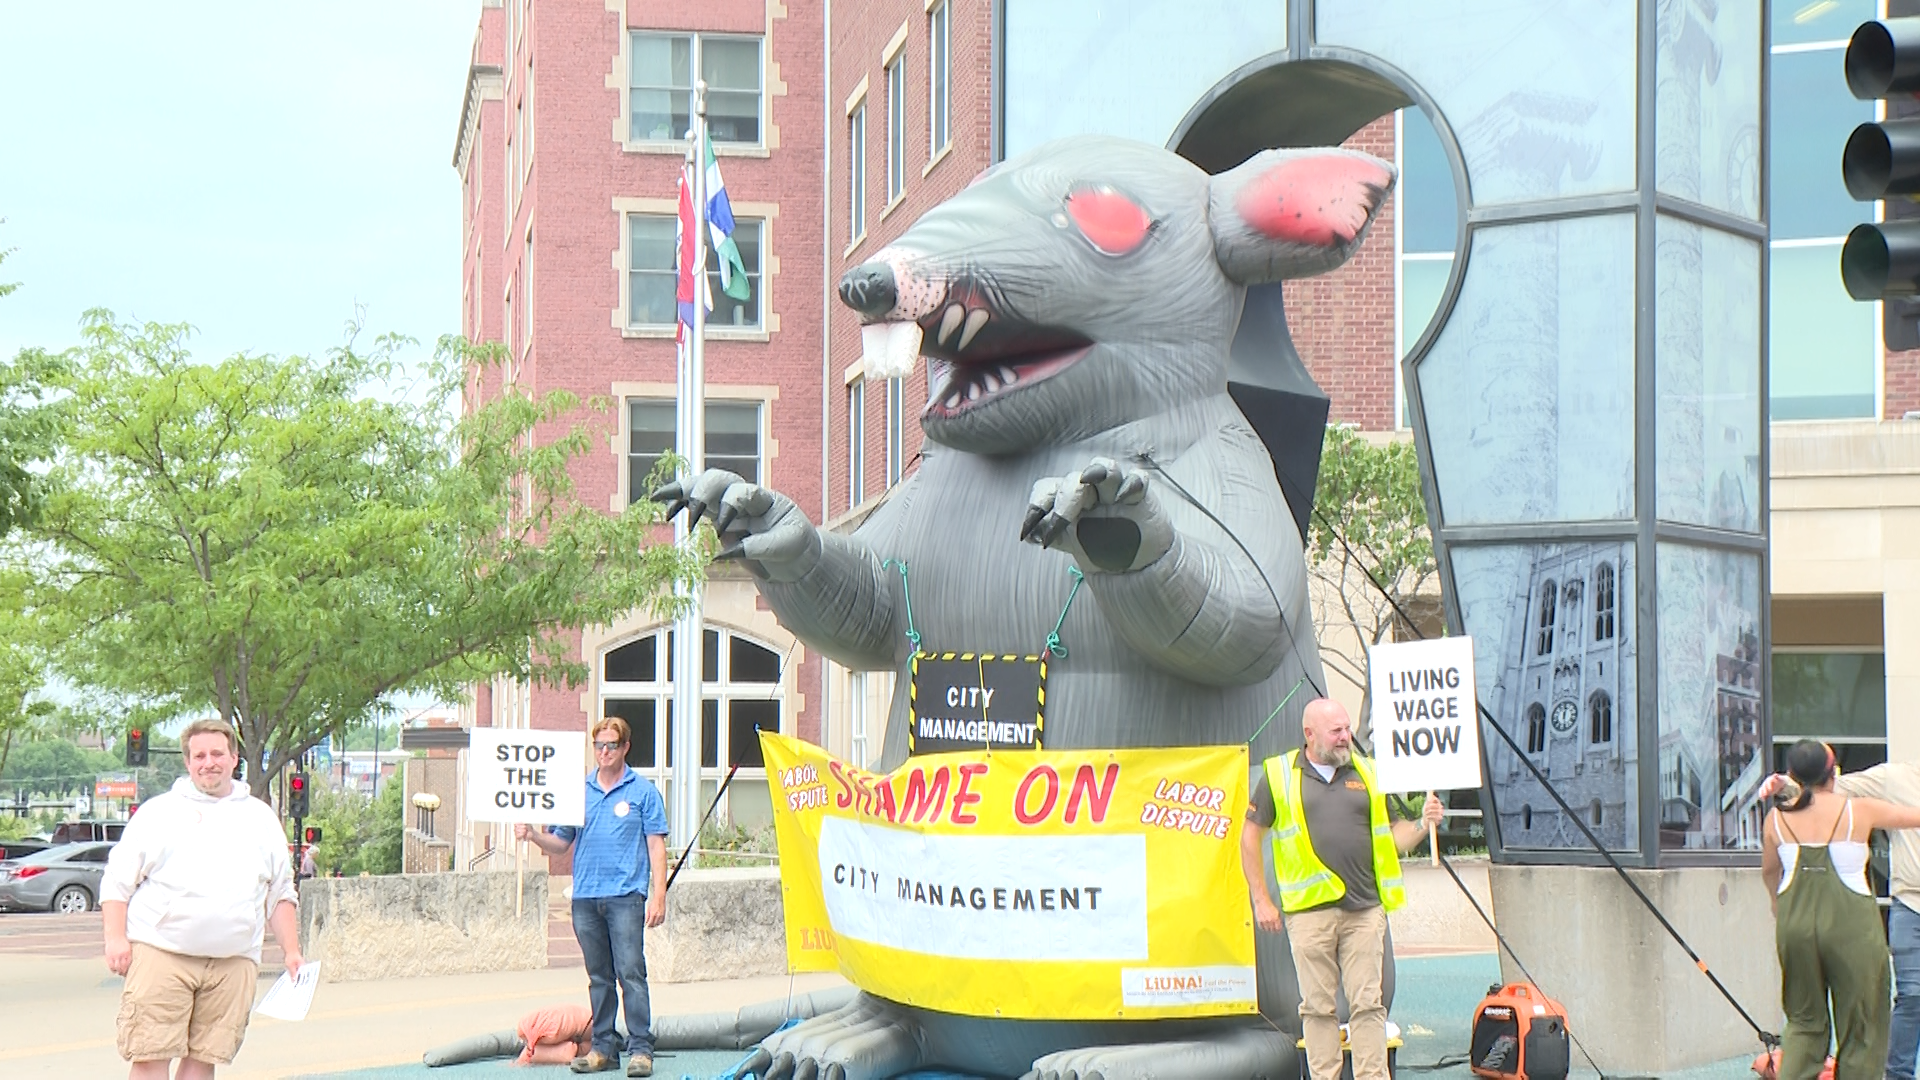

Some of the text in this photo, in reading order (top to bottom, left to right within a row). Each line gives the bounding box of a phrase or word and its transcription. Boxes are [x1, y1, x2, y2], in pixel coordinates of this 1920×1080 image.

[1389, 667, 1460, 693] LIVING
[946, 686, 995, 708] CITY
[1393, 697, 1459, 722] WAGE
[920, 717, 1037, 744] MANAGEMENT
[1392, 725, 1461, 757] NOW
[496, 743, 556, 763] STOP
[503, 767, 547, 786] THE
[780, 763, 820, 789] ABOR
[495, 790, 555, 810] CUTS
[786, 784, 829, 811] SPUTE
[829, 760, 1120, 825] SHAME ON
[1154, 778, 1226, 811] LABOR
[1140, 801, 1232, 839] DISPUTE
[833, 862, 1102, 911] CITY MANAGEMENT
[1145, 975, 1203, 990] LiUNA!
